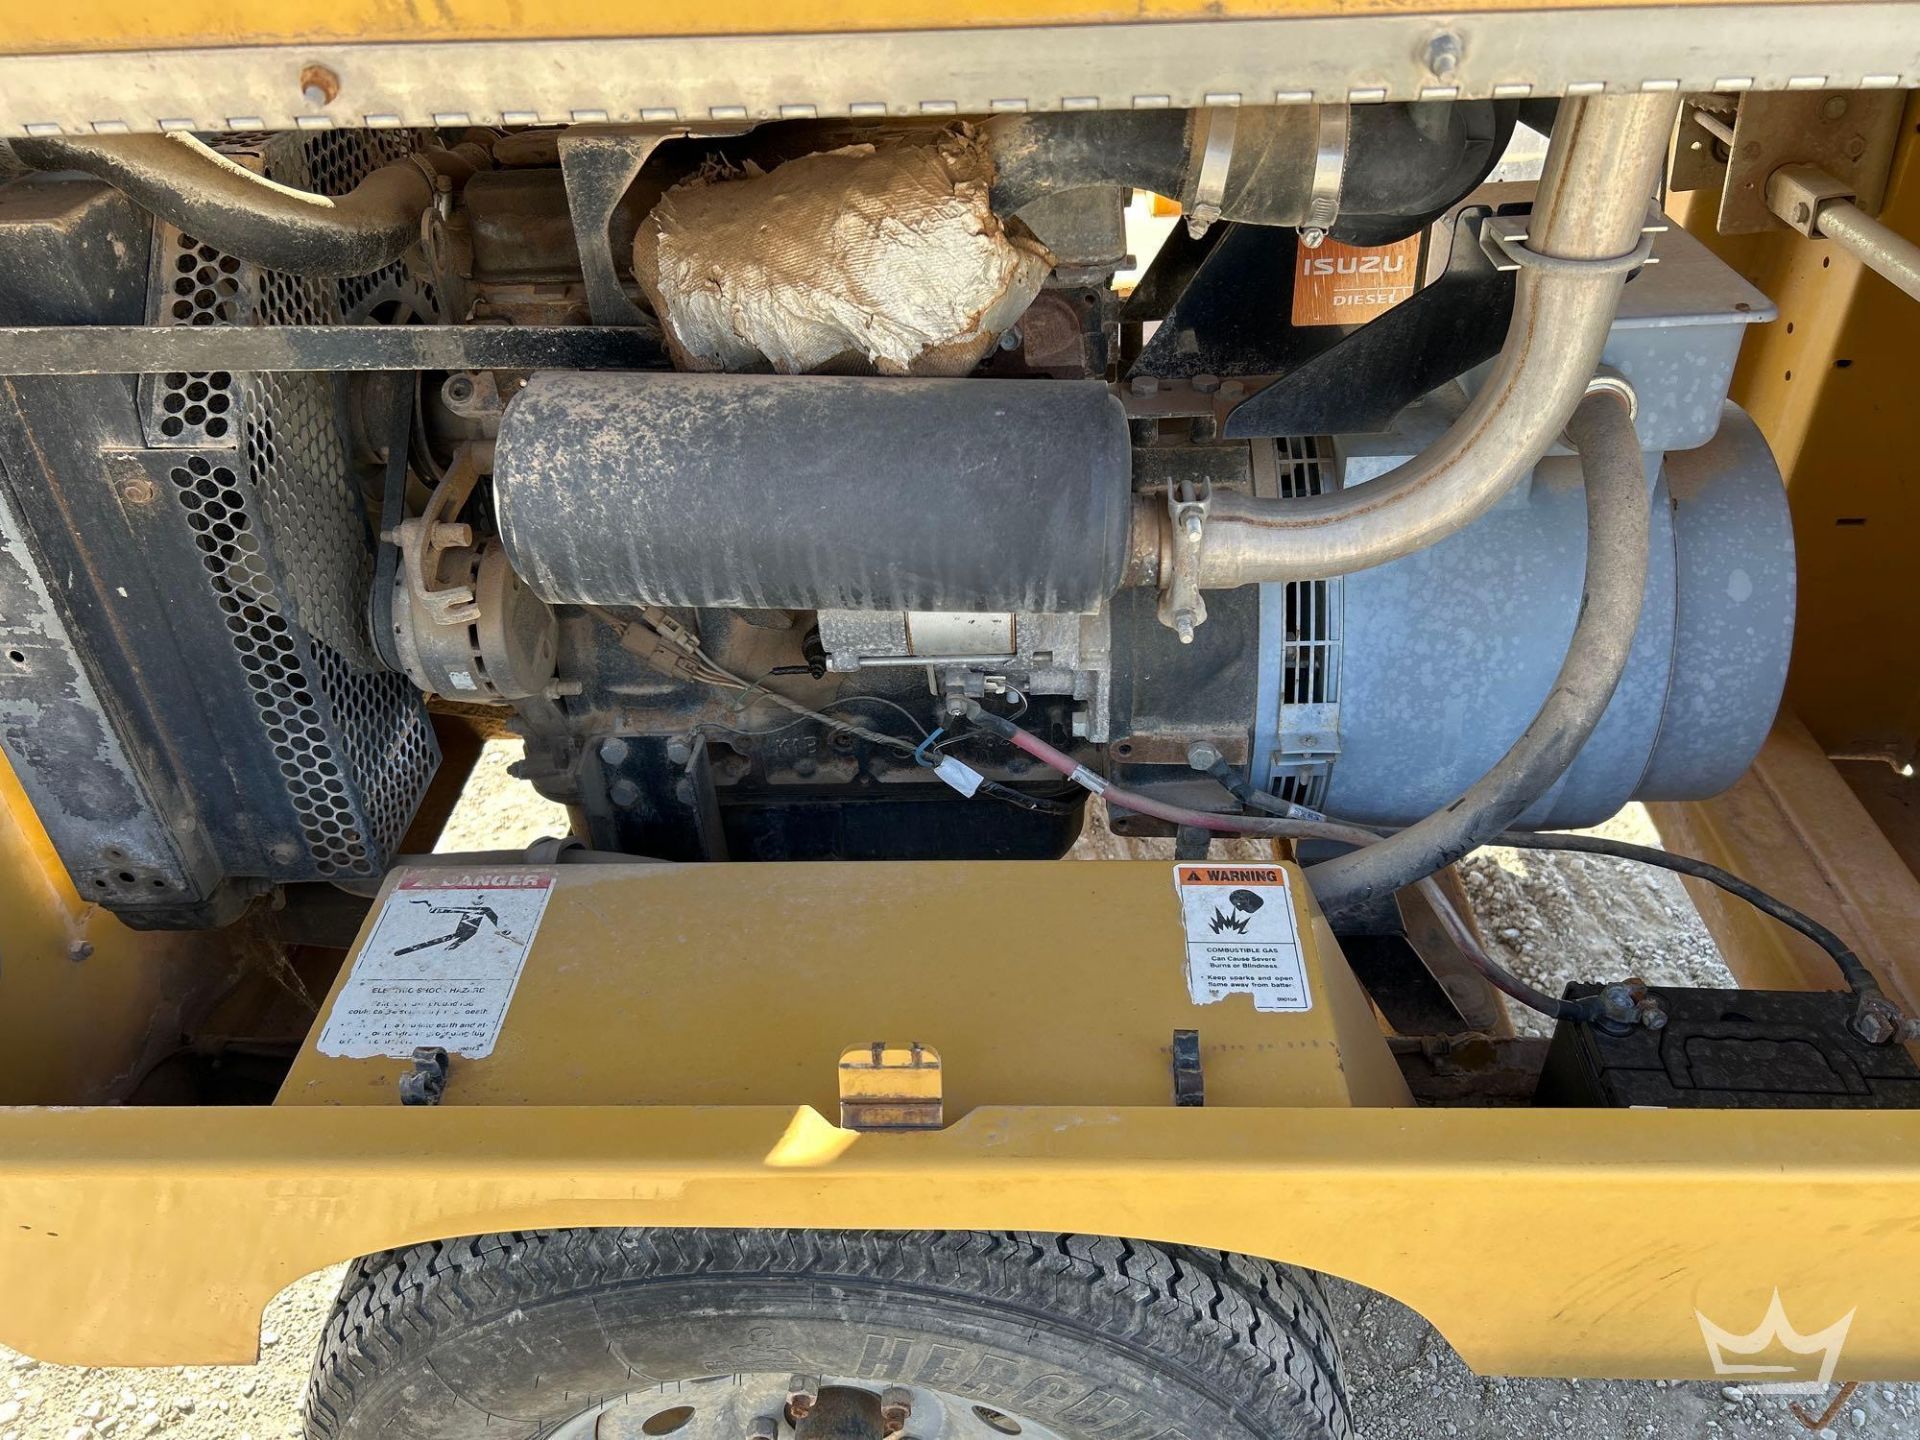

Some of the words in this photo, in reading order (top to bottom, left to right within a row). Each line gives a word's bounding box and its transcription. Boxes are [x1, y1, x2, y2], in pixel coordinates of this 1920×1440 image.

[1303, 255, 1404, 276] ISUZU
[1333, 293, 1398, 306] DIESEL
[1206, 870, 1278, 882] WARNING
